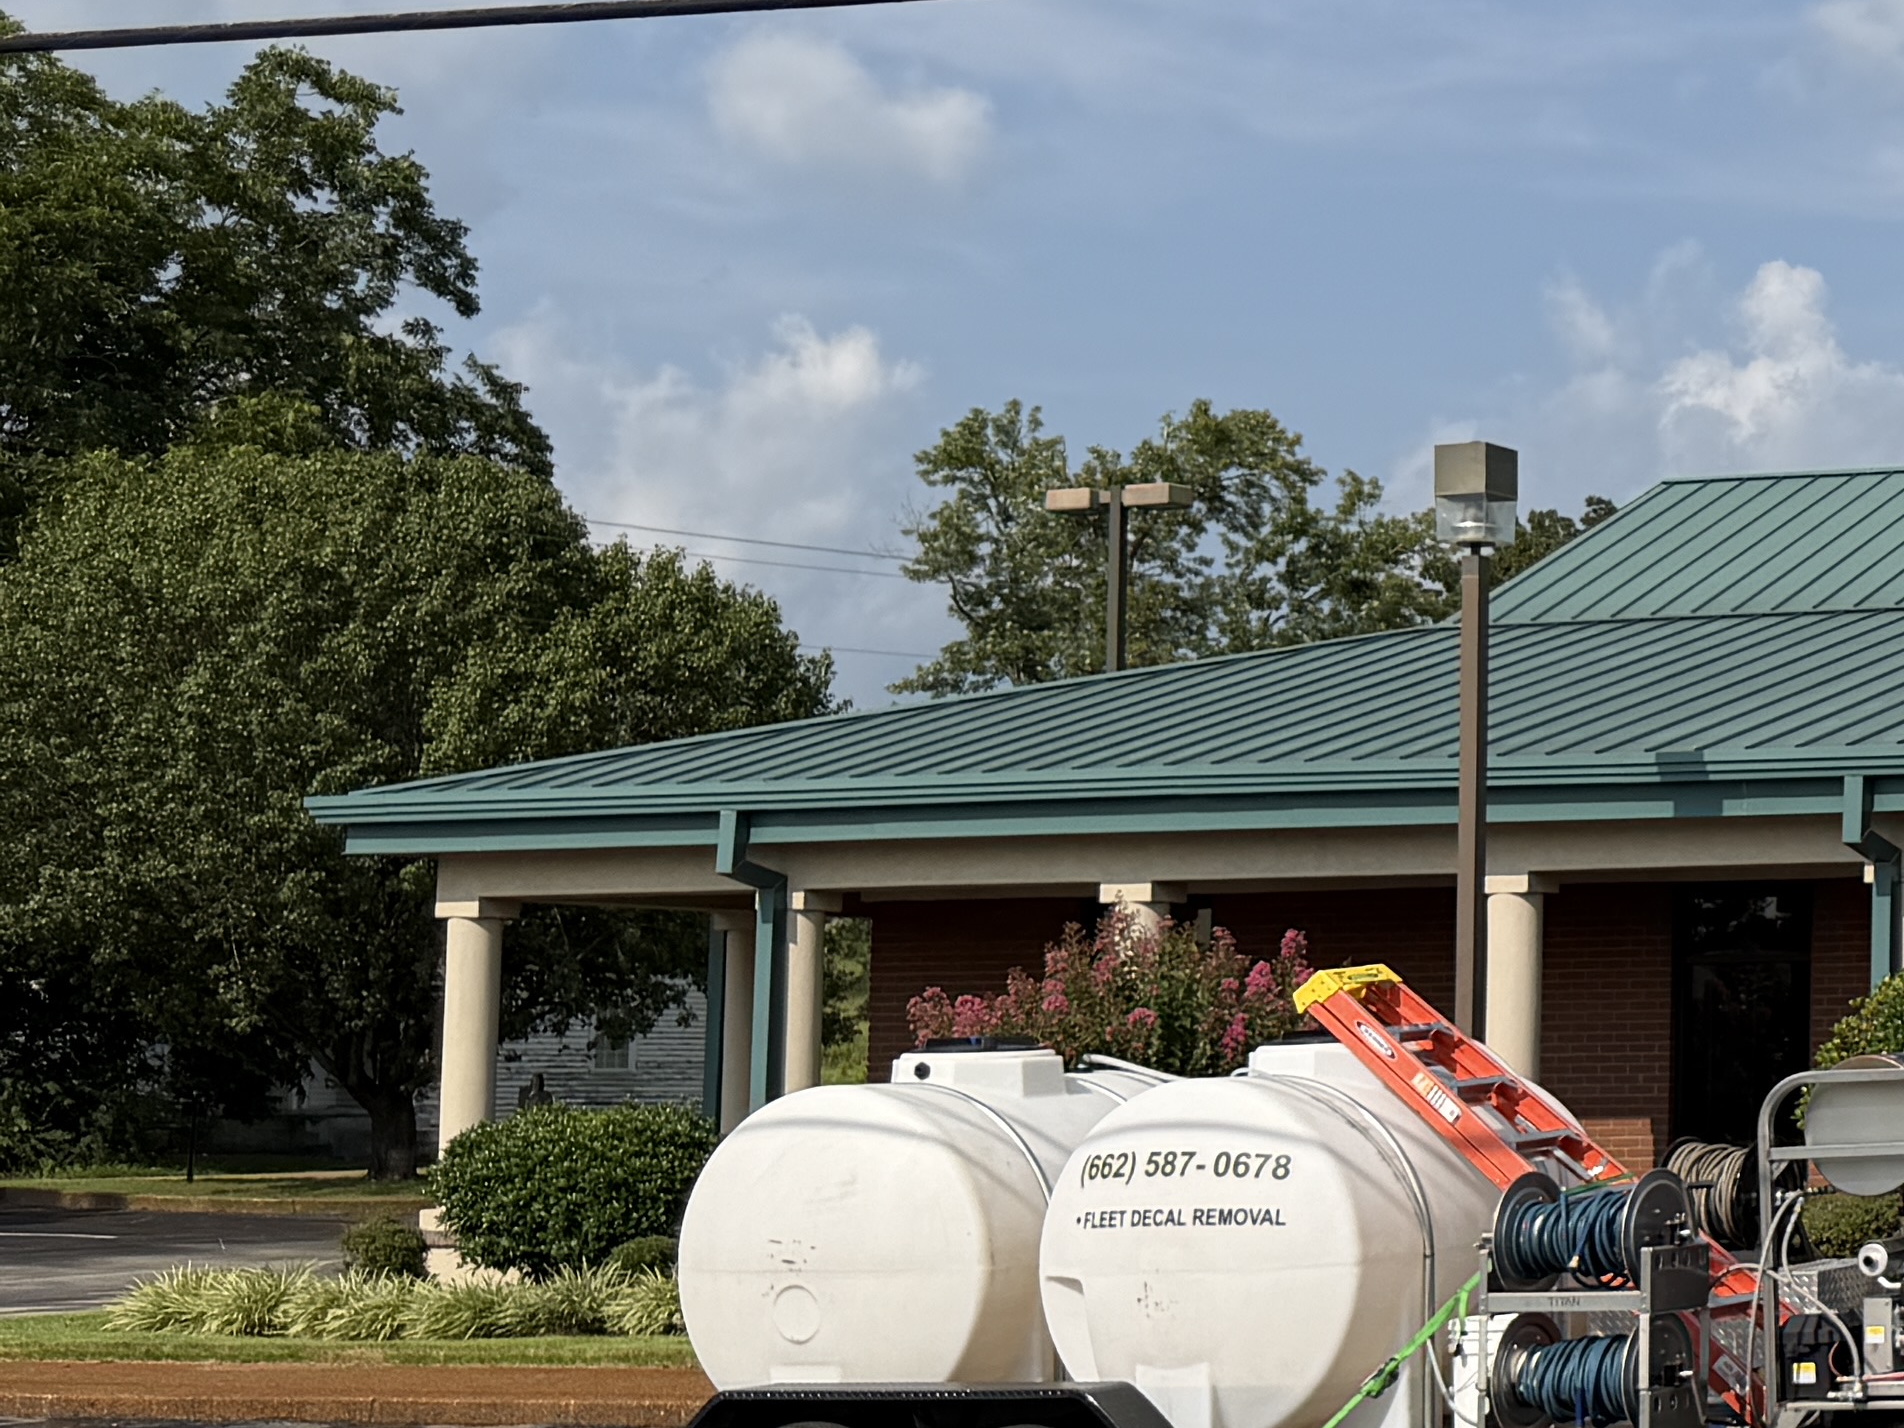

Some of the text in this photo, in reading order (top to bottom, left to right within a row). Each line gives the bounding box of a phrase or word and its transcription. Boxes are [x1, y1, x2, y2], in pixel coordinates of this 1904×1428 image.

[1080, 1151, 1292, 1188] (662) 587- 0678
[1083, 1207, 1286, 1229] FLEET DECAL REMOVAL
